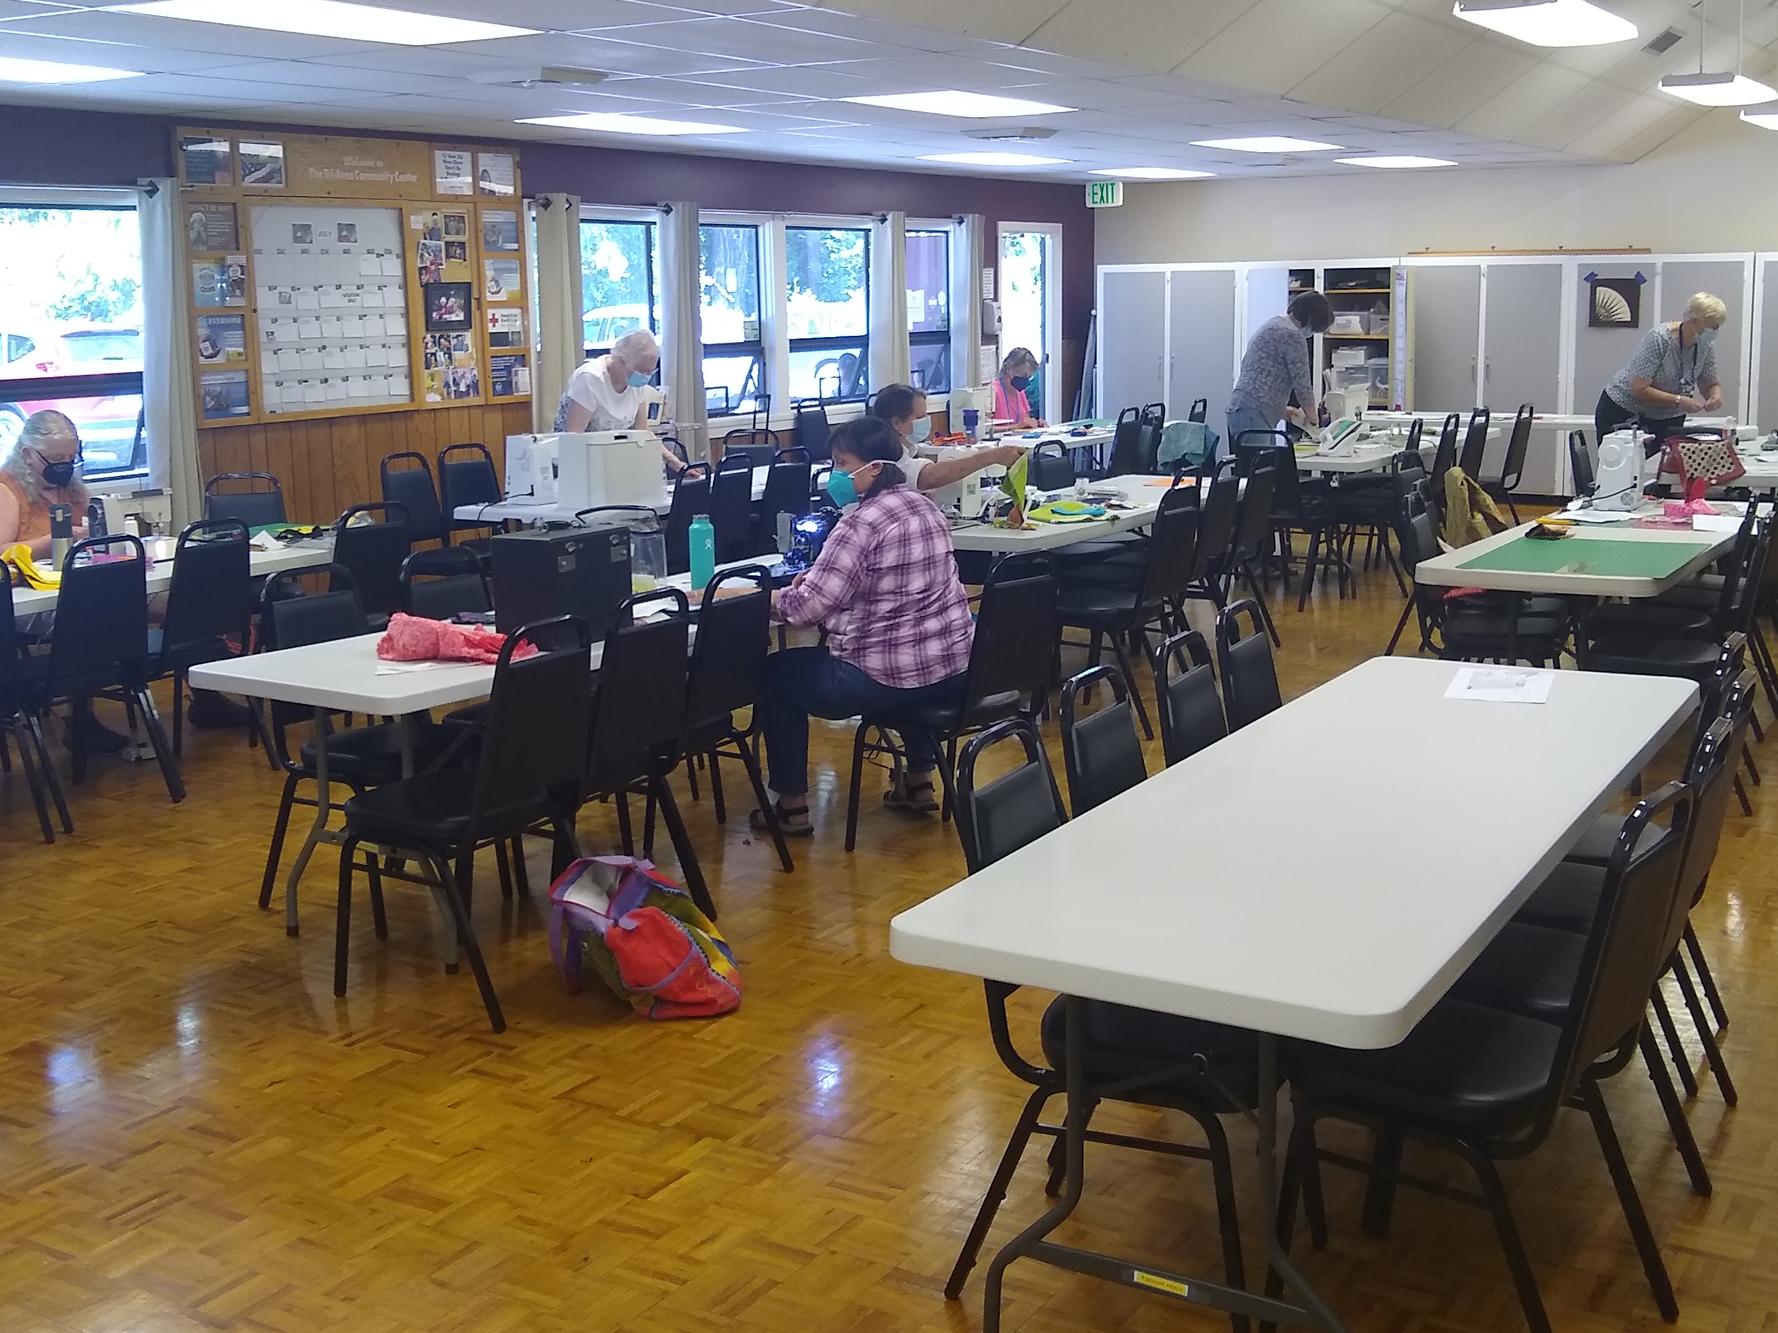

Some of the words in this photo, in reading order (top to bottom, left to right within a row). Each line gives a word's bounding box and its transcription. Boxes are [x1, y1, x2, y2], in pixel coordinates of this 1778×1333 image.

[342, 155, 375, 167] Welcome
[308, 168, 323, 179] The
[354, 170, 394, 184] Community
[394, 171, 418, 183] Center
[1091, 182, 1116, 205] EXIT
[318, 230, 333, 238] JULY
[208, 316, 242, 325] EVERYONE
